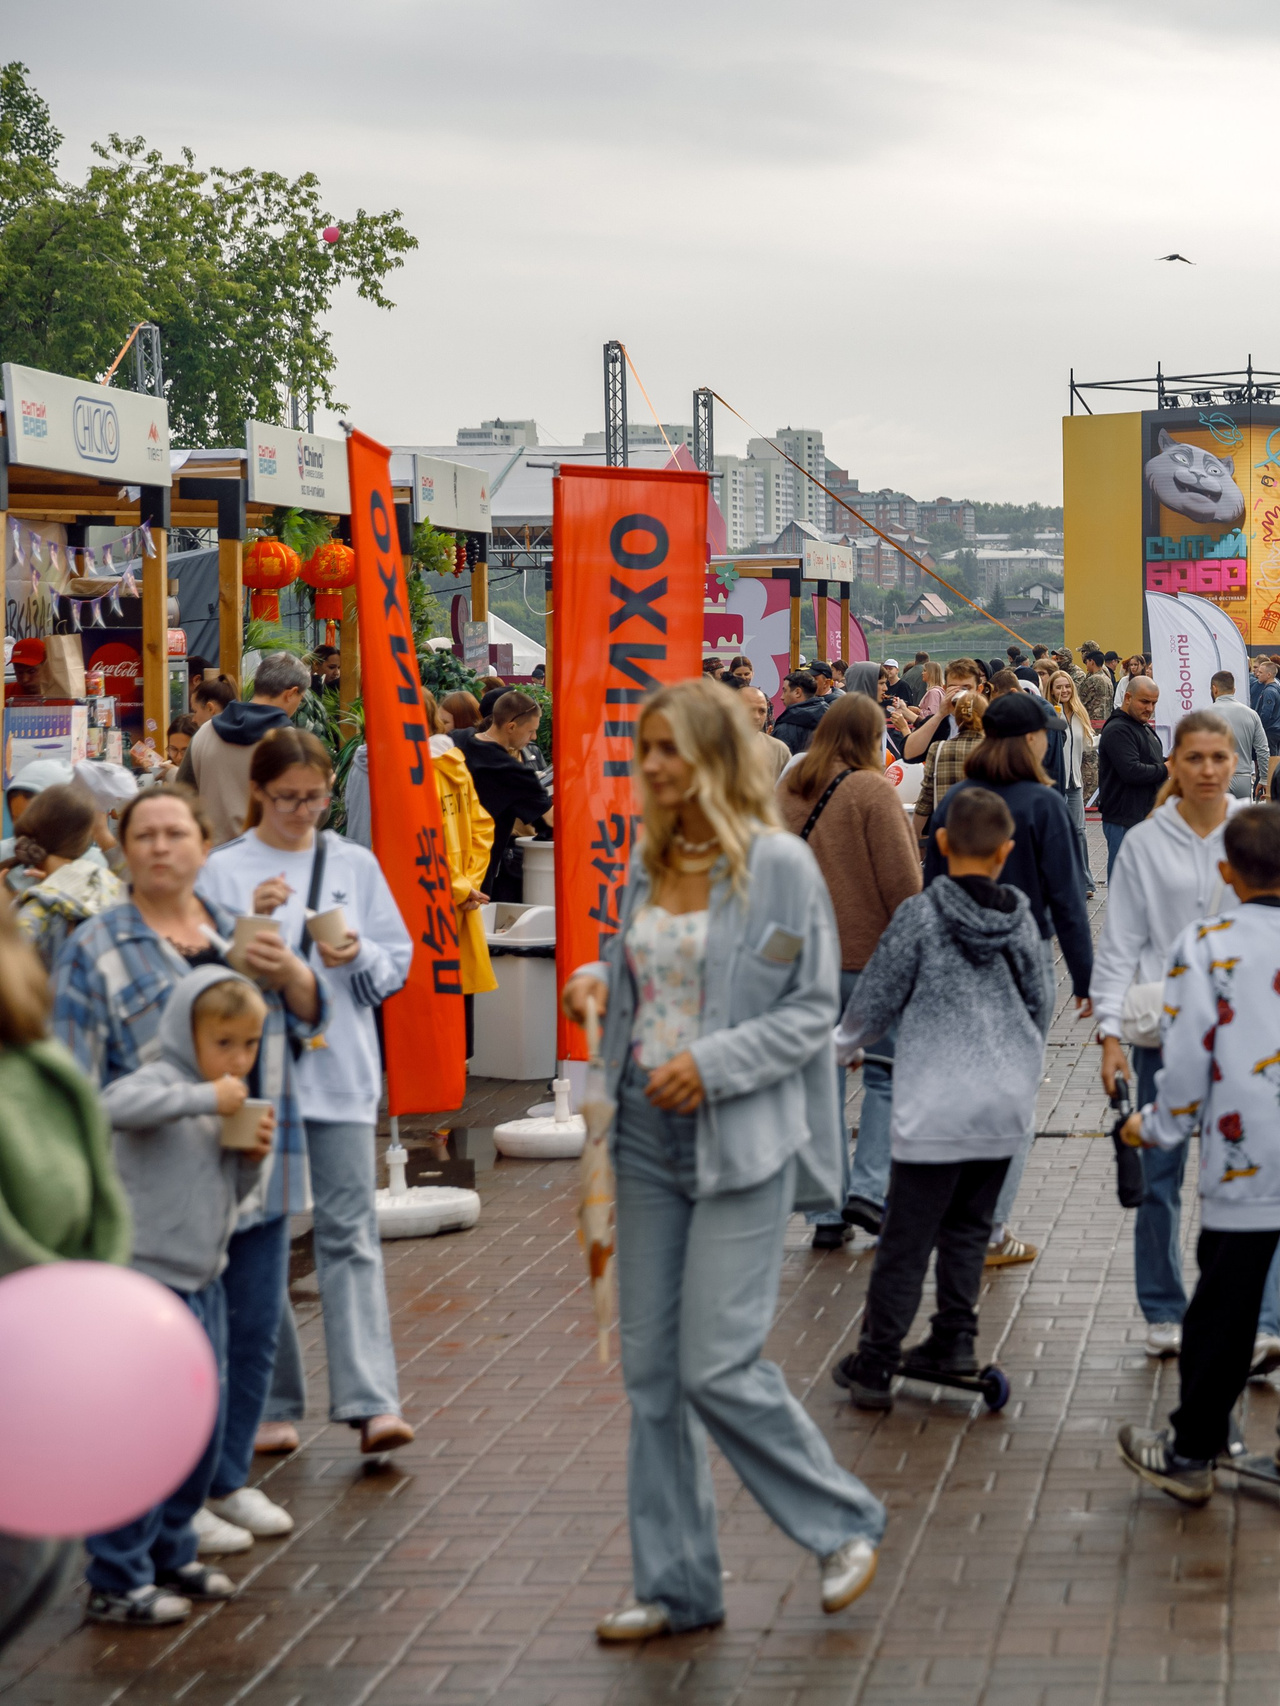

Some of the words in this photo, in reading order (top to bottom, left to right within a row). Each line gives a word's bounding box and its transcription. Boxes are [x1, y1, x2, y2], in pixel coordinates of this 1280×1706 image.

[21, 400, 47, 419] СЫТЫЙ
[22, 416, 48, 438] БАБР
[1146, 528, 1247, 560] СЫТЫЙ
[1146, 559, 1247, 592] БАБР
[91, 660, 142, 678] Coca-Cola
